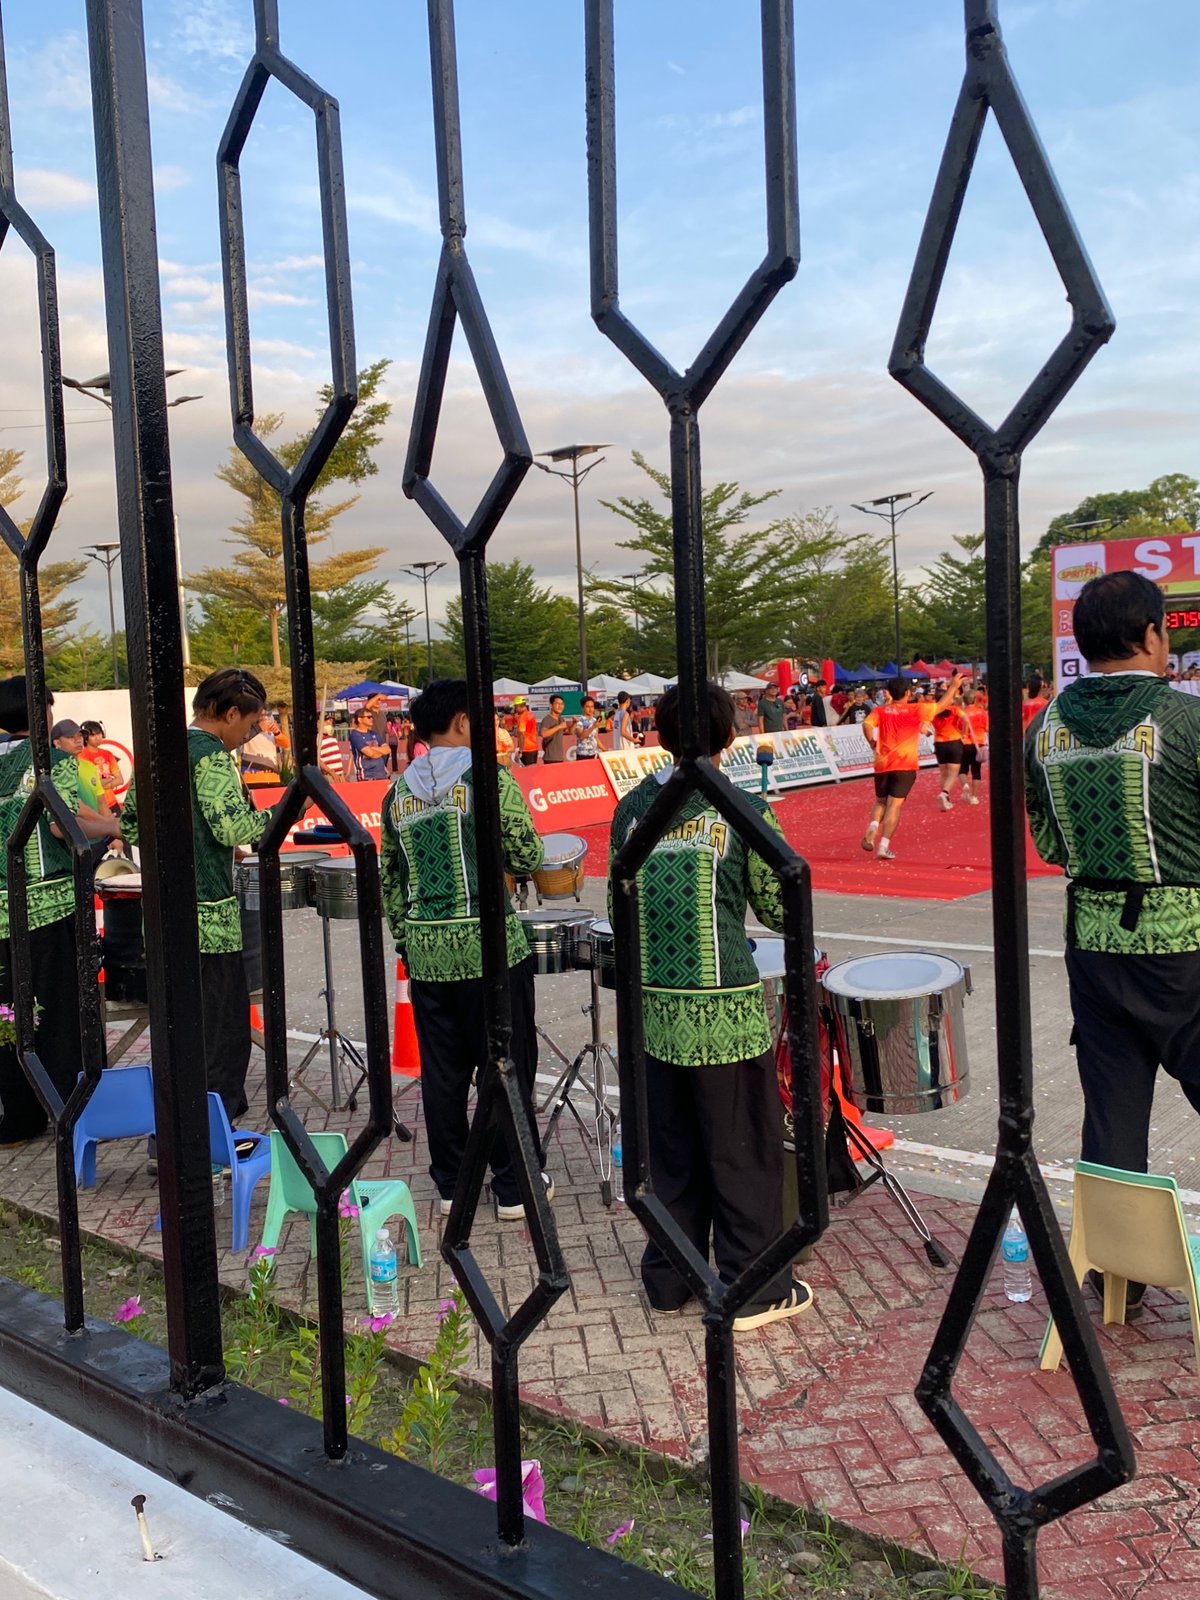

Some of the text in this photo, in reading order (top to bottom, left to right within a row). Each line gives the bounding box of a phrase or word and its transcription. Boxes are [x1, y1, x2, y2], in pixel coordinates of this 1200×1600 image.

[720, 743, 756, 768] CARE
[782, 735, 822, 759] CARE
[606, 752, 673, 781] RL CAR
[530, 784, 608, 811] G GATORADE
